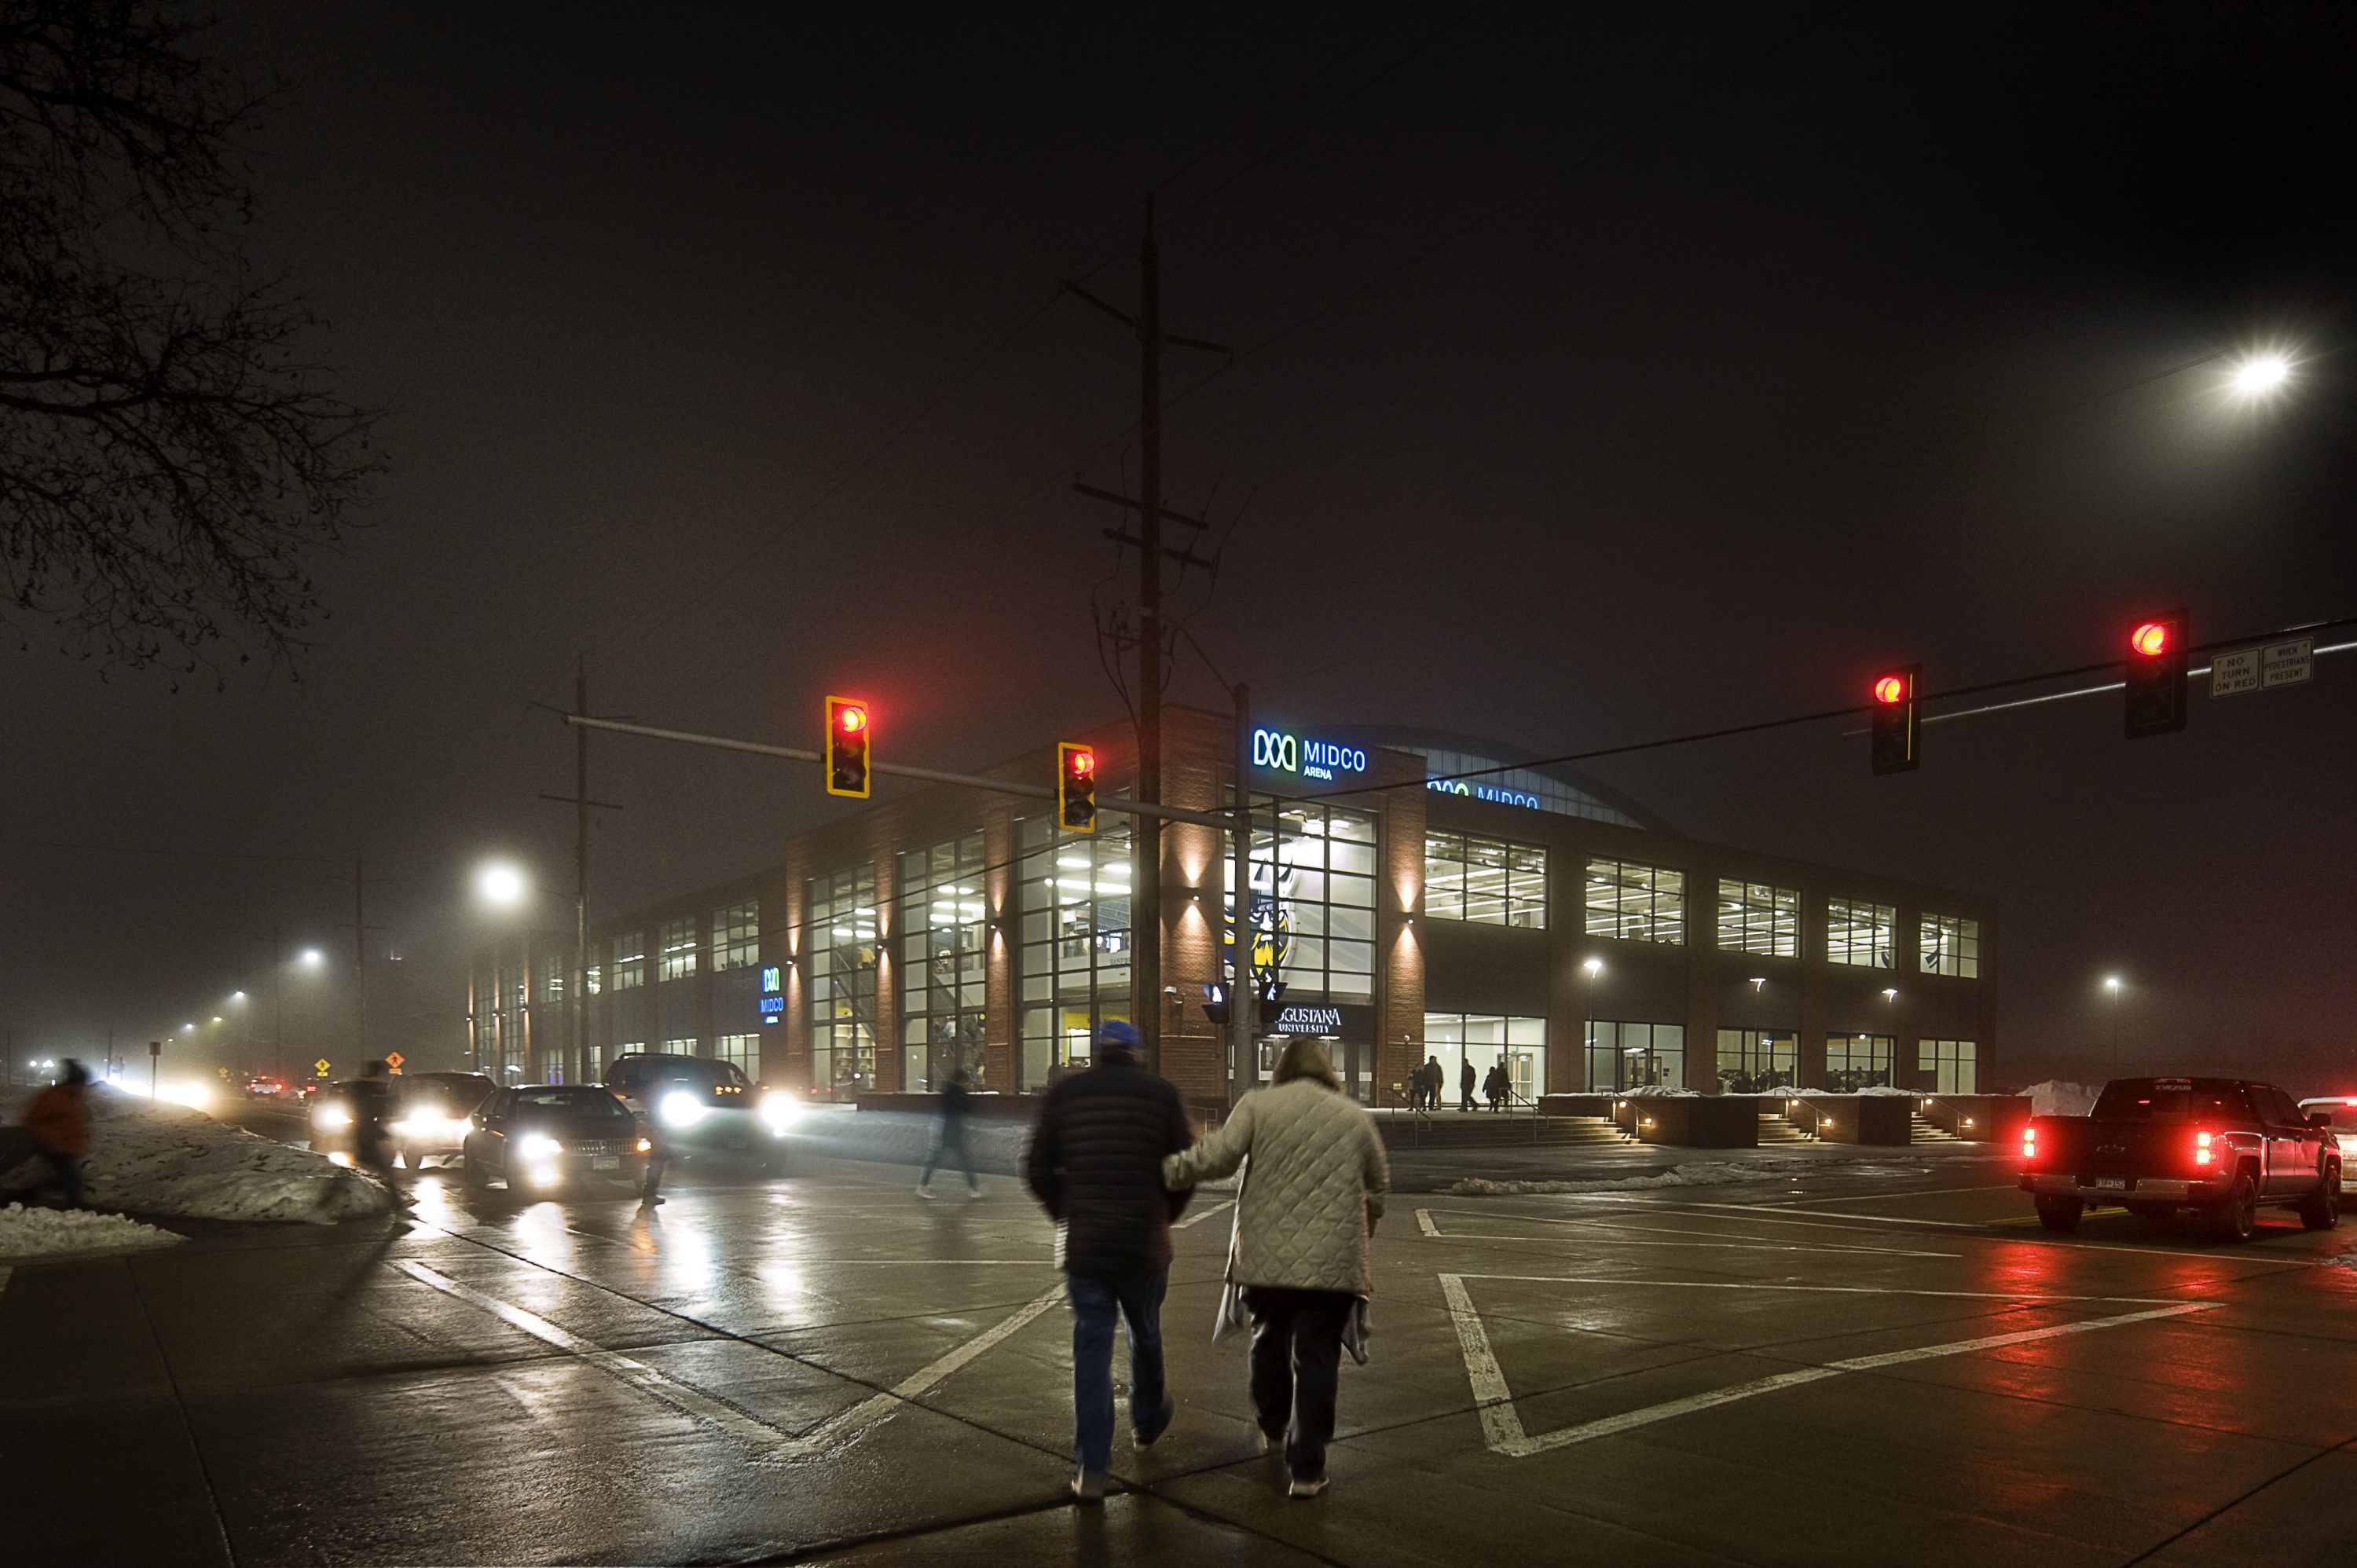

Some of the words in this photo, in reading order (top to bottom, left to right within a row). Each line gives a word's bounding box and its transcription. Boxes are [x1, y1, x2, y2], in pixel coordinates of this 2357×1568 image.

[2277, 646, 2298, 658] WHEN
[2227, 657, 2245, 668] NO
[2264, 655, 2310, 672] PEDESTRIANS
[2221, 666, 2250, 680] TURN
[2269, 668, 2303, 682] PRESENT
[2216, 683, 2230, 692] ON
[2234, 677, 2256, 689] RED
[1304, 740, 1365, 772] MIDCO
[1303, 765, 1332, 781] ARENA
[760, 997, 783, 1013] MIDCO
[1275, 1007, 1342, 1026] GUSTANA
